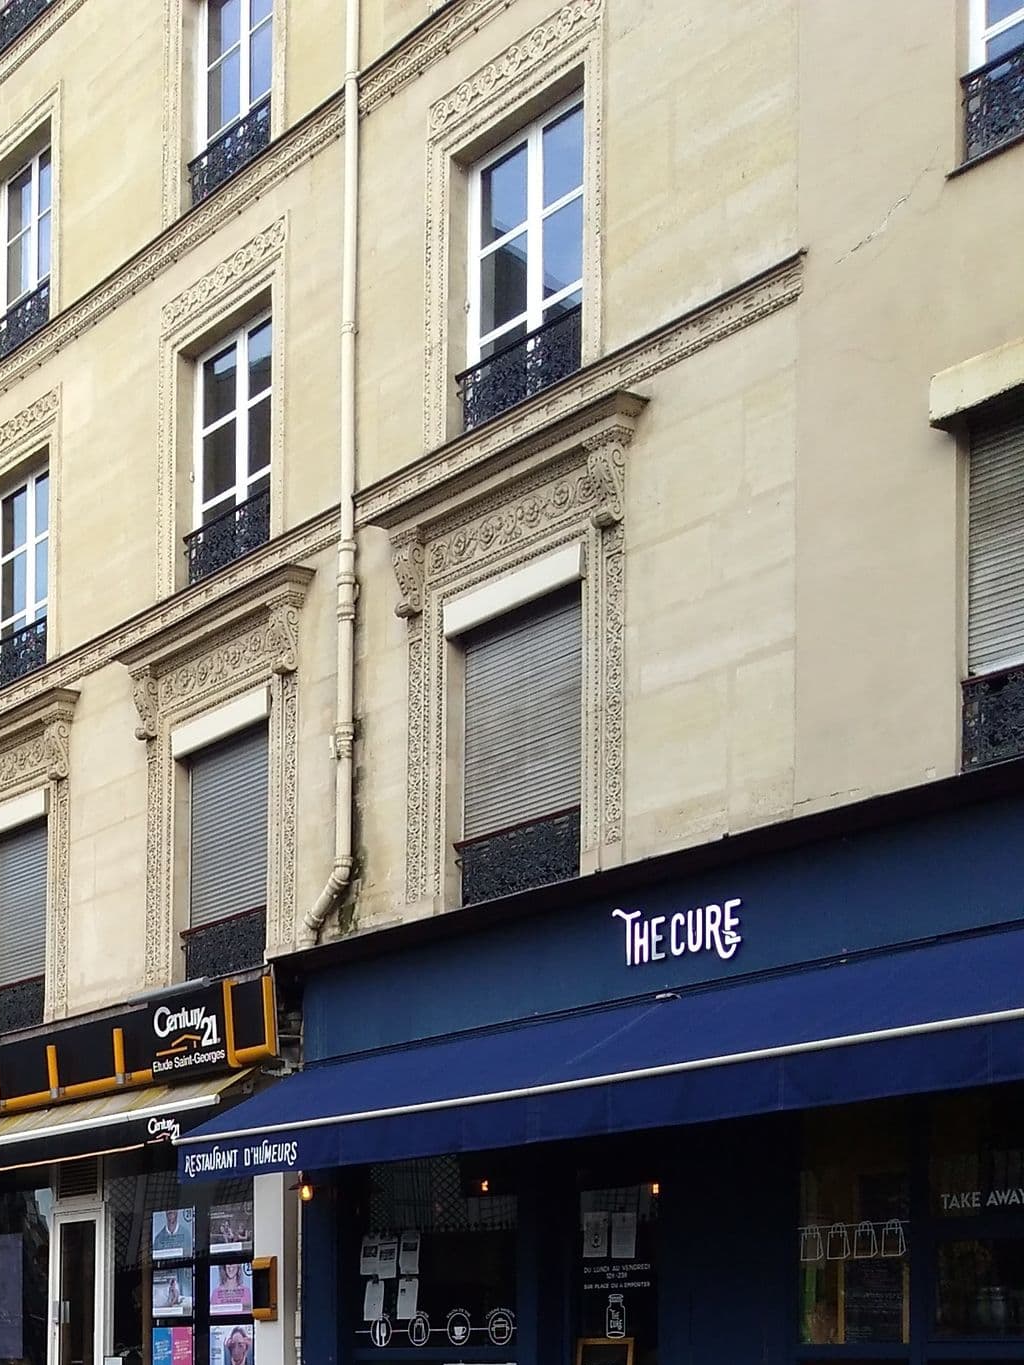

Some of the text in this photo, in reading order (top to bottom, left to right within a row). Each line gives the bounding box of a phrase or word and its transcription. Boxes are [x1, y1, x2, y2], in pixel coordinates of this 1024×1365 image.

[612, 898, 742, 966] THE CURE
[154, 1006, 218, 1047] Century 21
[152, 1049, 226, 1073] Etude Saint-Georges
[147, 1117, 181, 1143] Century 21
[184, 1139, 298, 1178] RESTAURANT D'HUMEURS
[940, 1191, 982, 1210] TAKE
